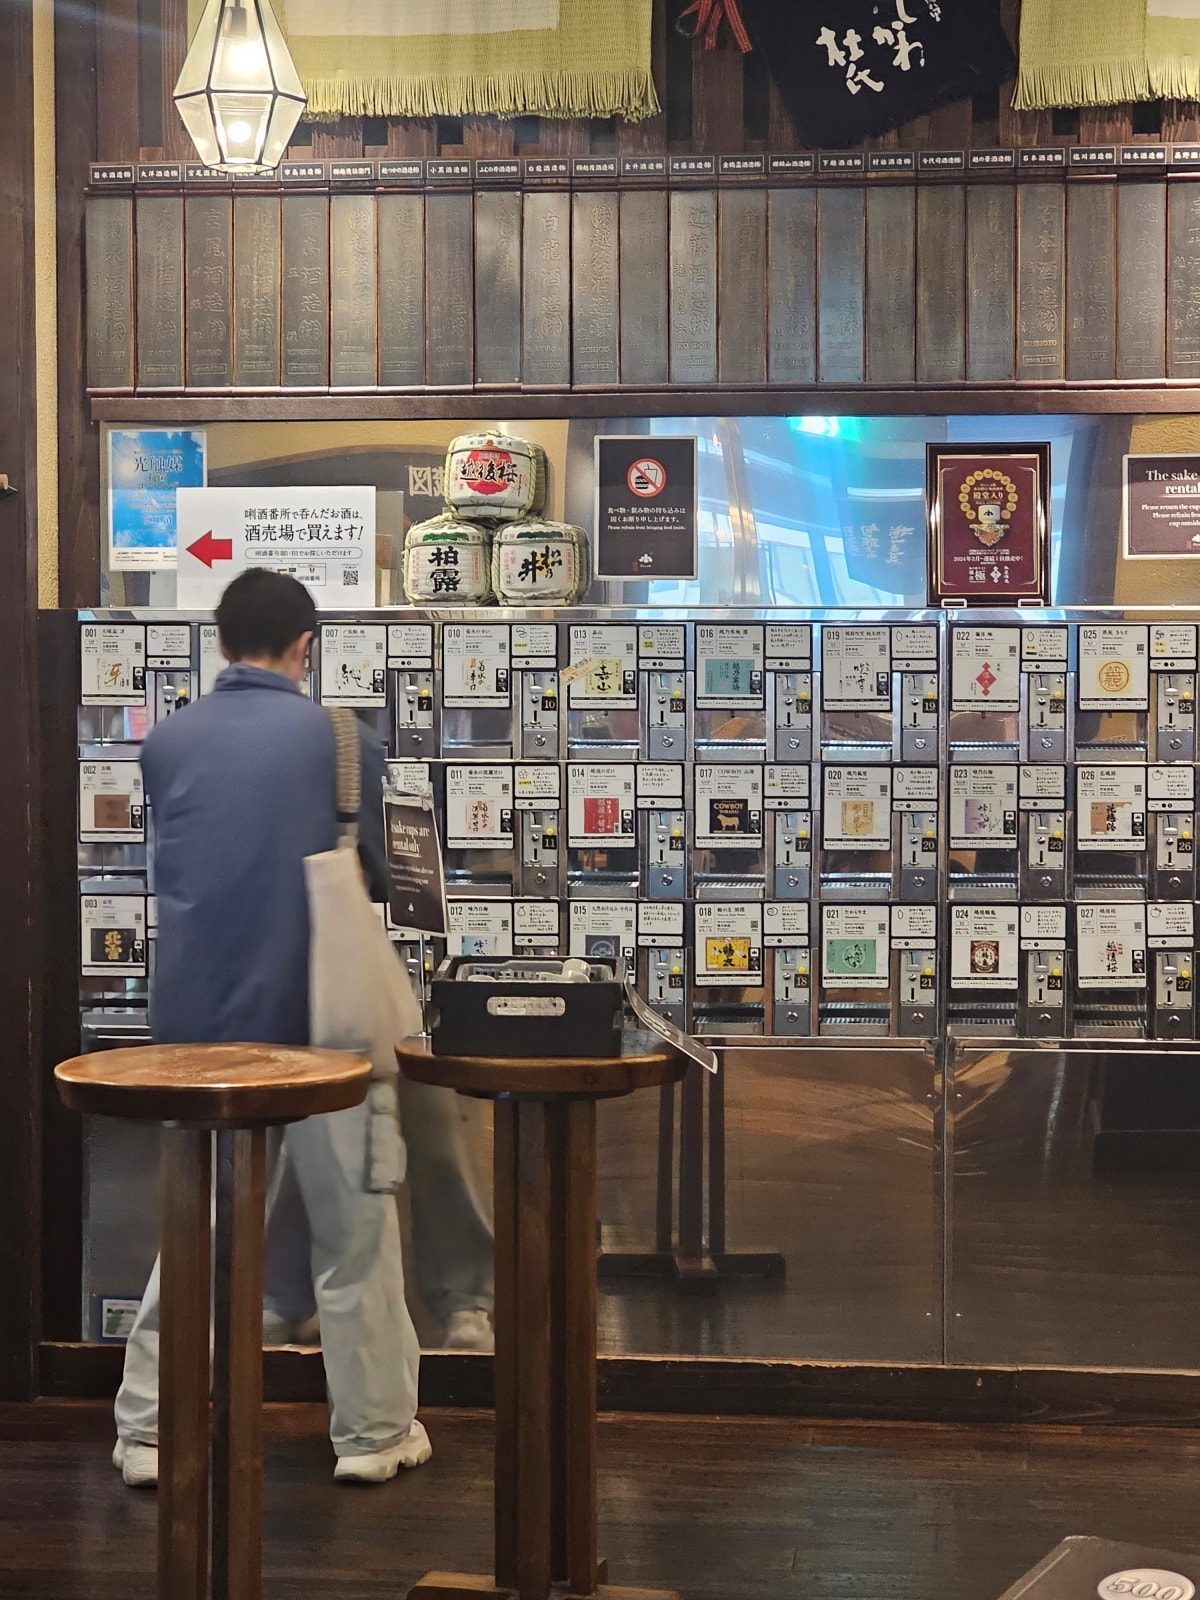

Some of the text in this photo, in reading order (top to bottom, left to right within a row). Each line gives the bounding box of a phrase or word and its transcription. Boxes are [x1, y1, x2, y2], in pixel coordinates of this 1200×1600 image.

[133, 456, 184, 473] 光触媒
[1145, 468, 1198, 481] The sake
[244, 524, 364, 542] 酒売場で買えます!
[428, 545, 462, 594] 柏露
[84, 628, 97, 638] 001
[203, 628, 216, 638] 004
[325, 628, 338, 638] 007
[447, 628, 461, 638] 010
[573, 629, 587, 639] 013
[700, 628, 714, 638] 016
[826, 631, 840, 640] 019
[956, 631, 970, 641] 022
[1083, 629, 1097, 639] 025
[421, 699, 427, 710] 7
[543, 699, 555, 709] 10
[672, 700, 683, 710] 13
[798, 701, 809, 711] 16
[924, 701, 935, 712] 19
[1179, 701, 1192, 712] 25
[83, 765, 97, 774] 002
[450, 769, 462, 779] 011
[572, 768, 585, 778] 014
[699, 768, 713, 778] 017
[953, 769, 968, 779] 023
[828, 770, 842, 780] 020
[1081, 770, 1095, 780] 026
[545, 838, 555, 848] 11
[671, 839, 683, 848] 14
[798, 840, 808, 849] 17
[922, 840, 934, 850] 20
[1050, 840, 1061, 850] 23
[1178, 841, 1191, 851] 26
[84, 899, 98, 908] 003
[450, 906, 463, 915] 012
[573, 905, 587, 915] 015
[699, 907, 712, 917] 018
[826, 909, 839, 919] 021
[955, 909, 969, 919] 024
[1080, 908, 1094, 918] 027
[671, 976, 681, 985] 15
[797, 976, 807, 986] 18
[921, 978, 933, 987] 21
[1049, 978, 1061, 988] 24
[1106, 1575, 1185, 1600] 500
